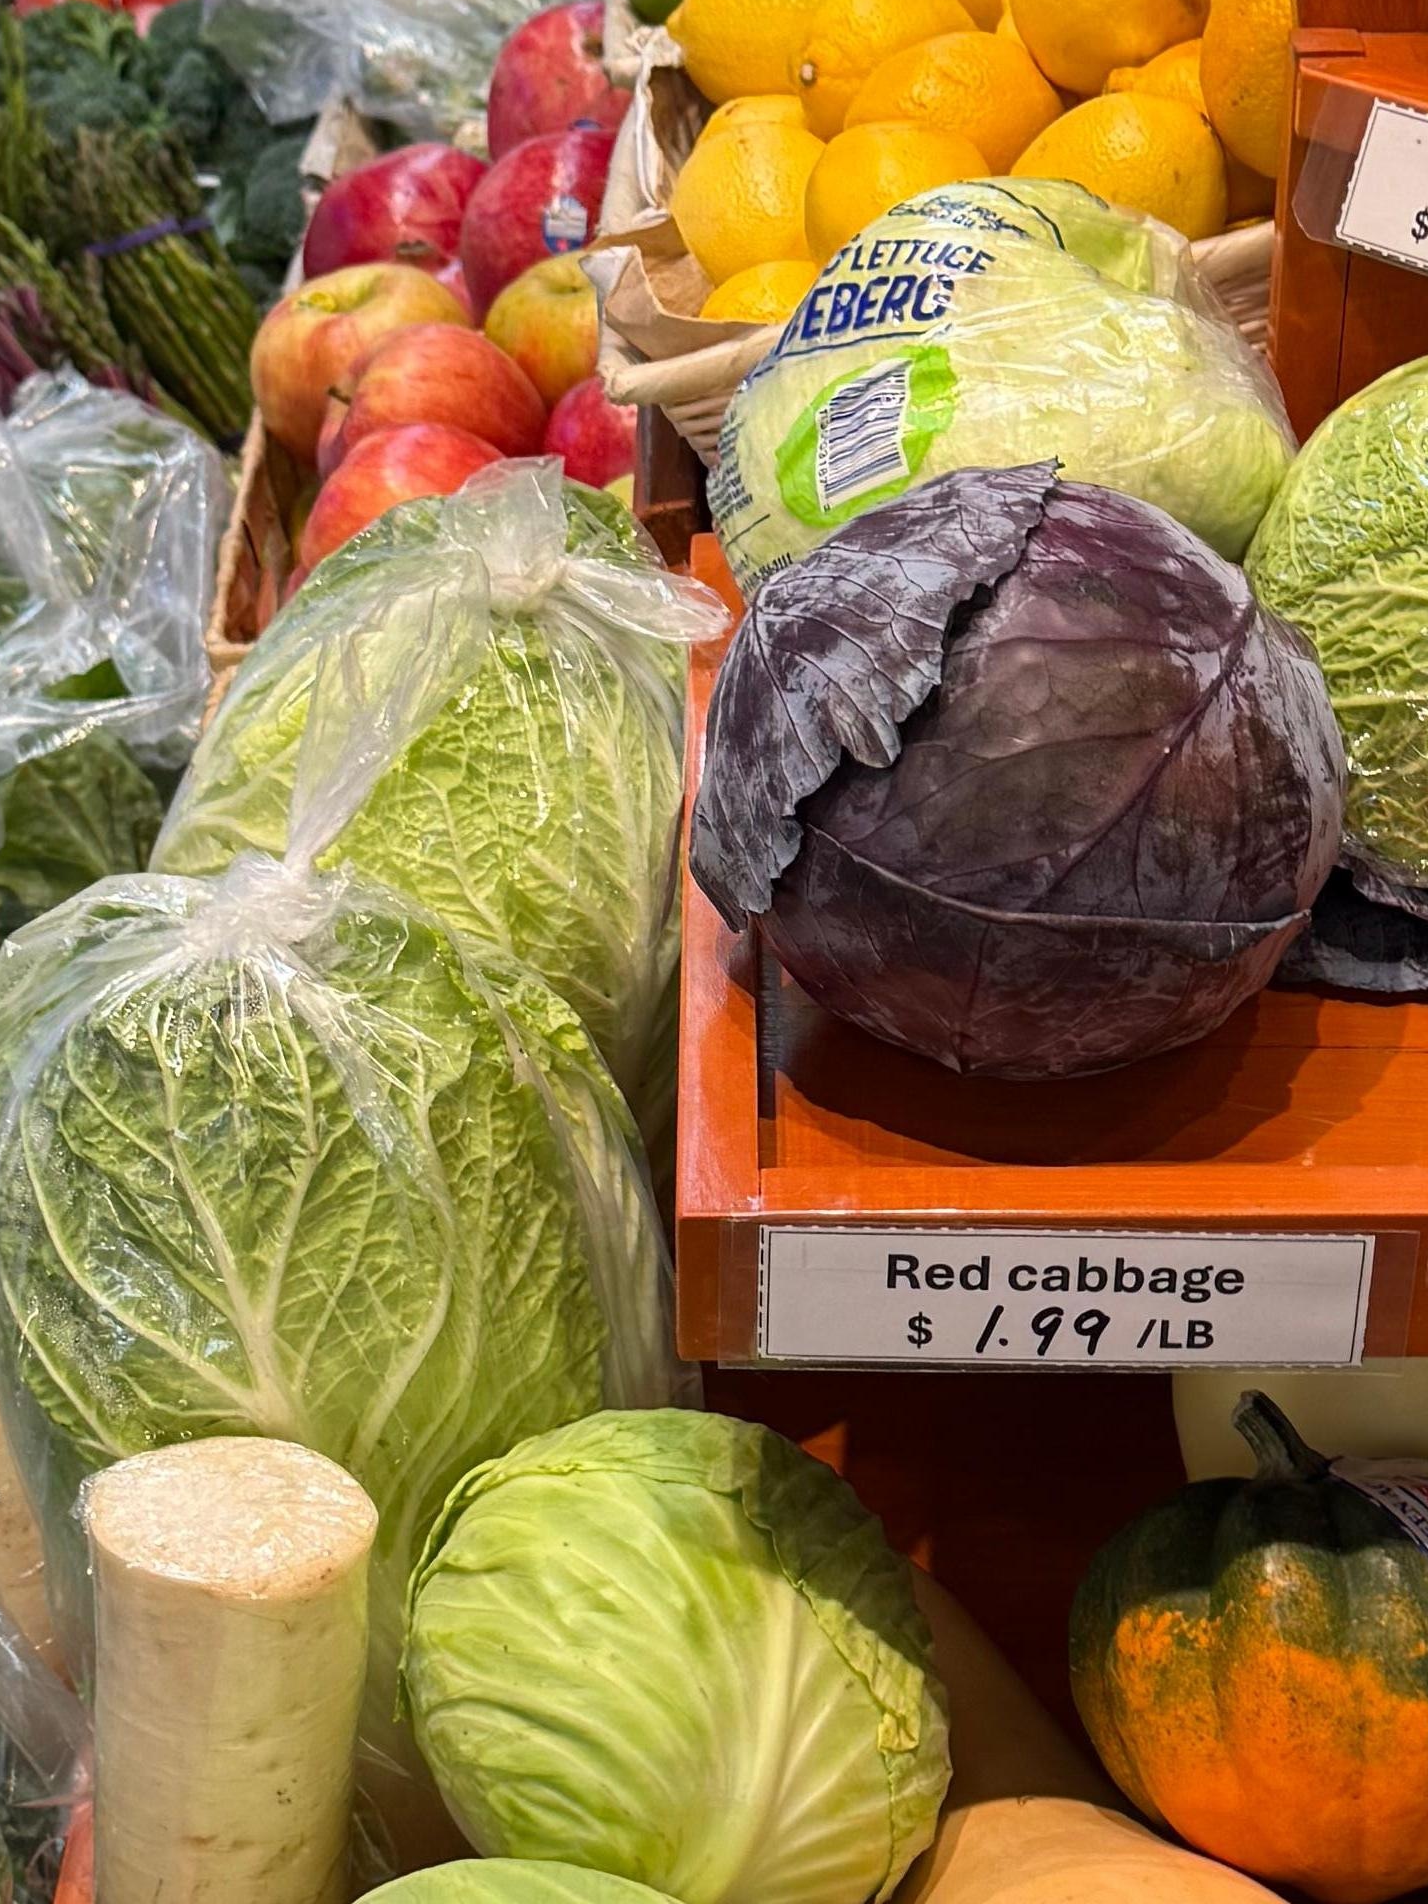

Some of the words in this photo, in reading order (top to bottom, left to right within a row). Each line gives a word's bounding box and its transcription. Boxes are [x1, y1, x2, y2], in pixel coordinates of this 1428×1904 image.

[850, 239, 997, 275] LETTUCE
[886, 1252, 991, 1292] Red
[1007, 1257, 1246, 1305] cabbage
[905, 1312, 934, 1349] $
[974, 1305, 1112, 1358] 1.99
[1136, 1317, 1215, 1350] /LB
